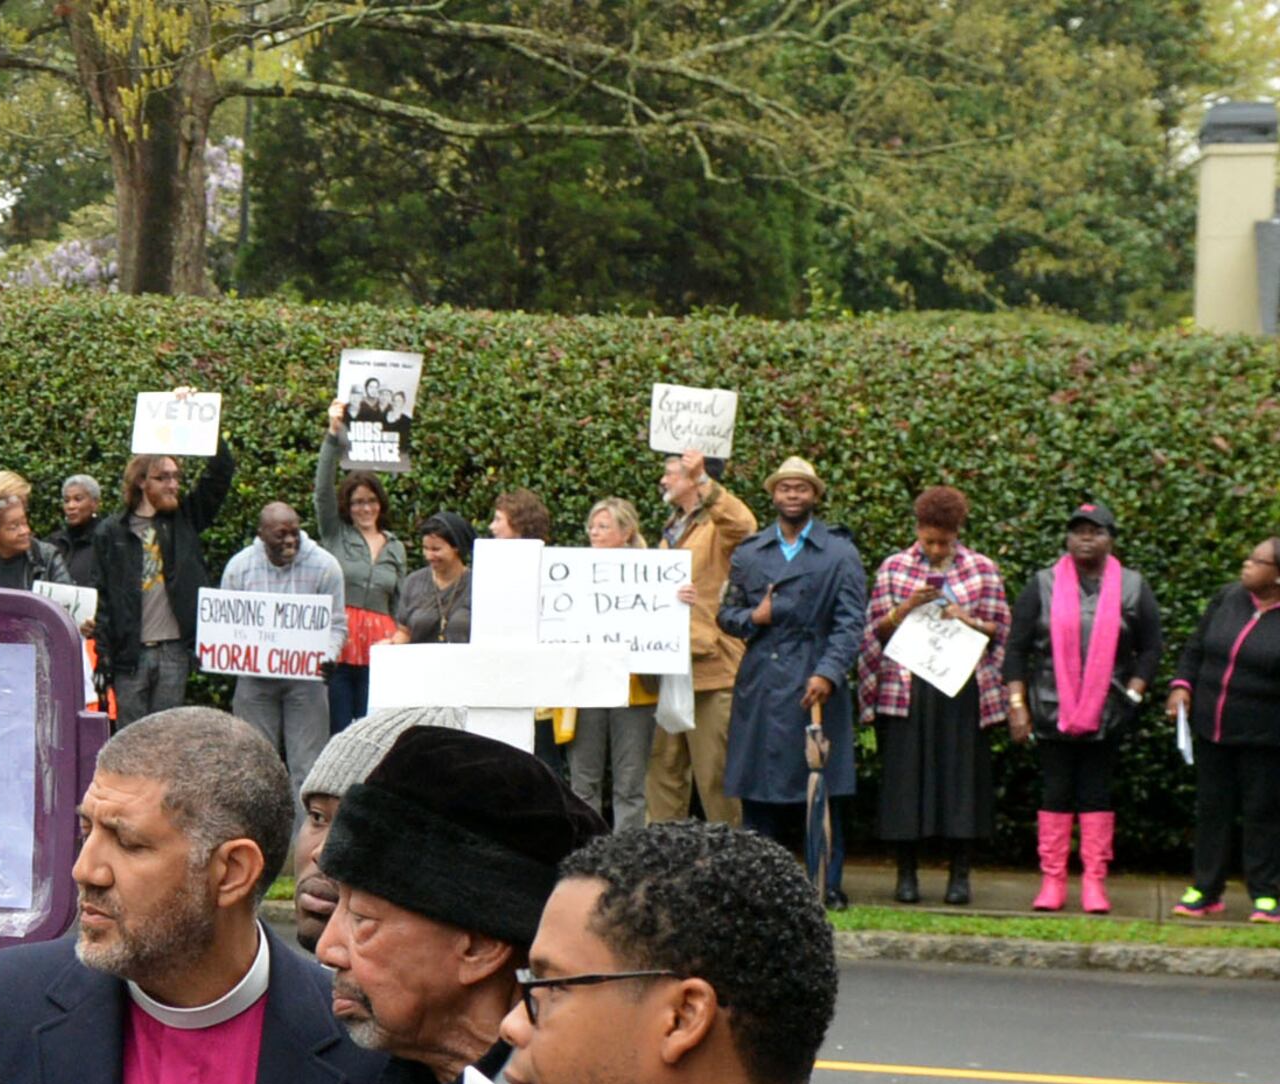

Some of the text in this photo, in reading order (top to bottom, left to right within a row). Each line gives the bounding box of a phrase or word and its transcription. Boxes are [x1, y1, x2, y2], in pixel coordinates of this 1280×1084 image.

[145, 400, 217, 423] VETO
[659, 389, 724, 423] Expand
[347, 421, 383, 441] JOBS
[655, 415, 733, 441] Medicaid
[348, 441, 401, 462] JUSTICE
[591, 562, 688, 584] ETHICS
[200, 597, 330, 631] EXPANDING MEDICAID
[541, 592, 671, 616] O DEAL
[259, 630, 276, 642] THE
[200, 641, 326, 677] MORAL CHOICE
